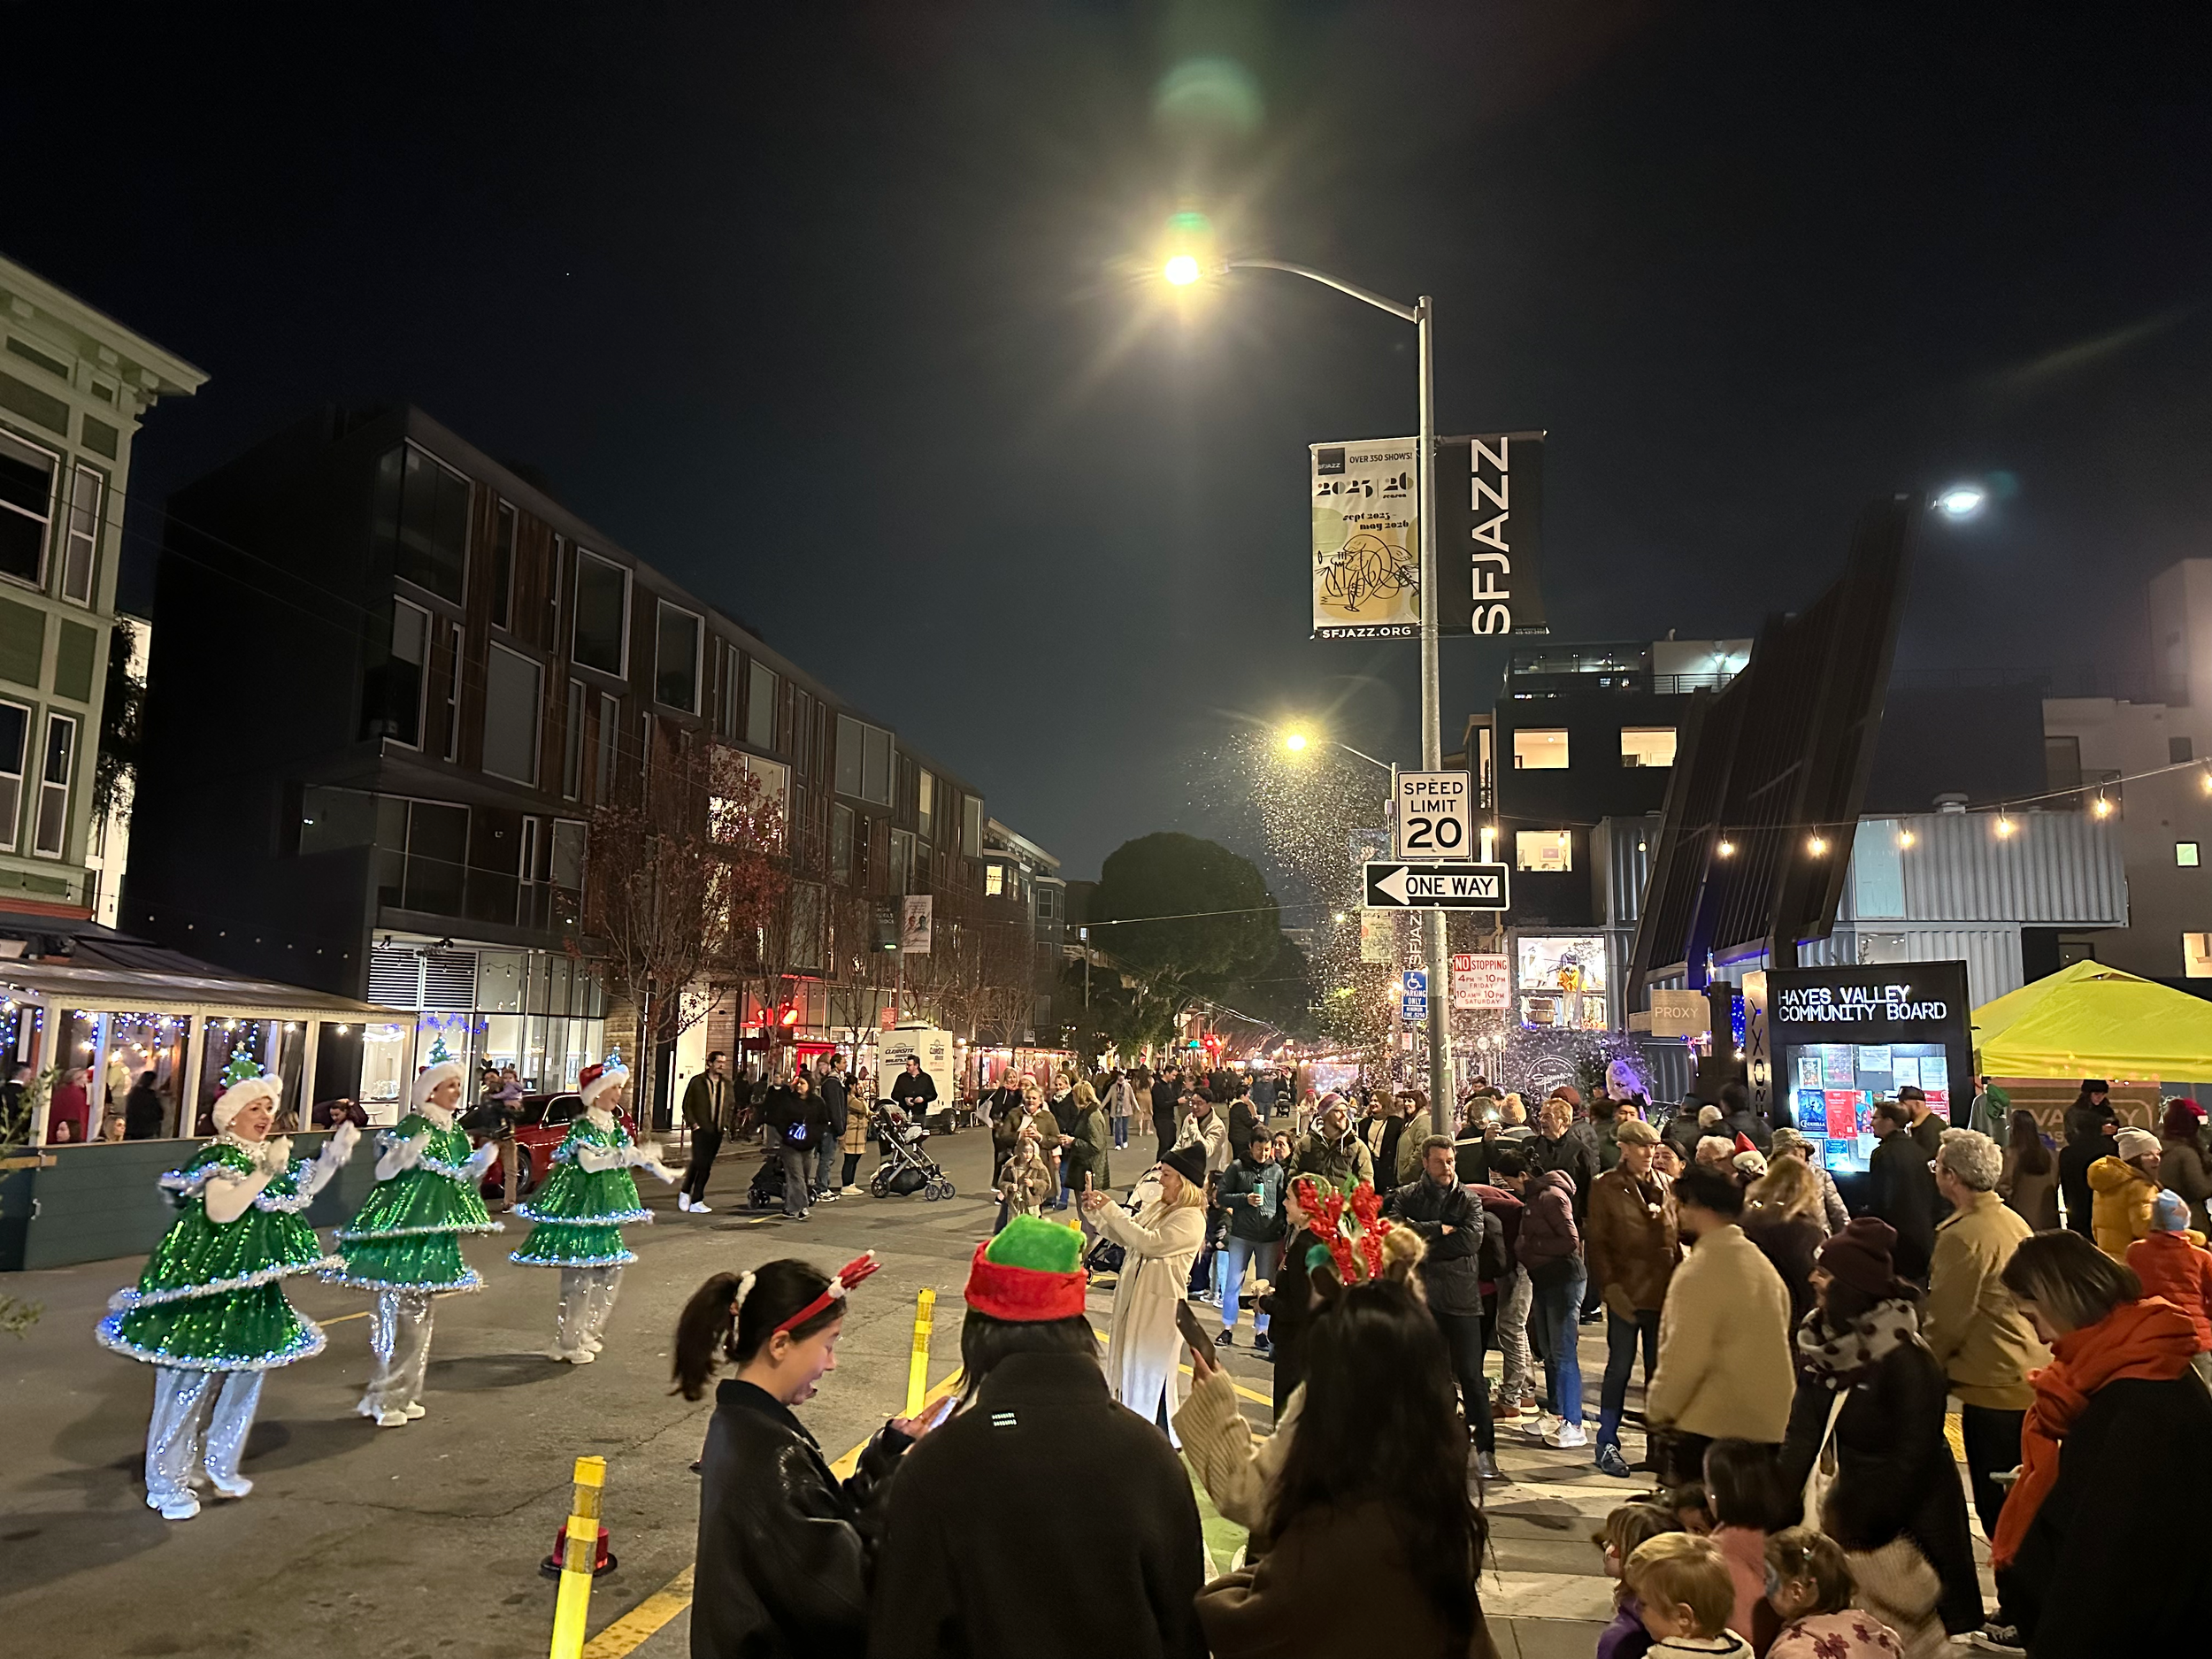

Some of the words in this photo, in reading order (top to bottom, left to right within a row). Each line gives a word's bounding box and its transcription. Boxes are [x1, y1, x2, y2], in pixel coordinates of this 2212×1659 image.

[1349, 455, 1369, 464] OVER
[1384, 452, 1413, 461] SHOWS!
[1316, 480, 1373, 498] 2025
[1342, 512, 1365, 523] sept
[1367, 512, 1391, 521] 2025
[1359, 523, 1383, 532] may
[1385, 519, 1409, 529] 2026
[1471, 436, 1511, 634] SFJAZZ
[1322, 626, 1411, 639] SFJAZZ.ORG
[1403, 781, 1463, 795] SPEED
[1410, 799, 1457, 812] LIMIT
[1407, 818, 1463, 849] 20
[1405, 877, 1446, 895] ONE
[1452, 877, 1494, 895] WAY
[1409, 910, 1423, 965] SFJAZ
[1455, 956, 1470, 971] NO
[1471, 960, 1507, 970] STOPPING
[1778, 987, 1832, 1006] HAYES
[1839, 984, 1911, 1004] VALLEY
[1655, 1006, 1699, 1018] PROXY
[1778, 1004, 1876, 1022] COMMUNITY
[1886, 1002, 1947, 1021] BOARD
